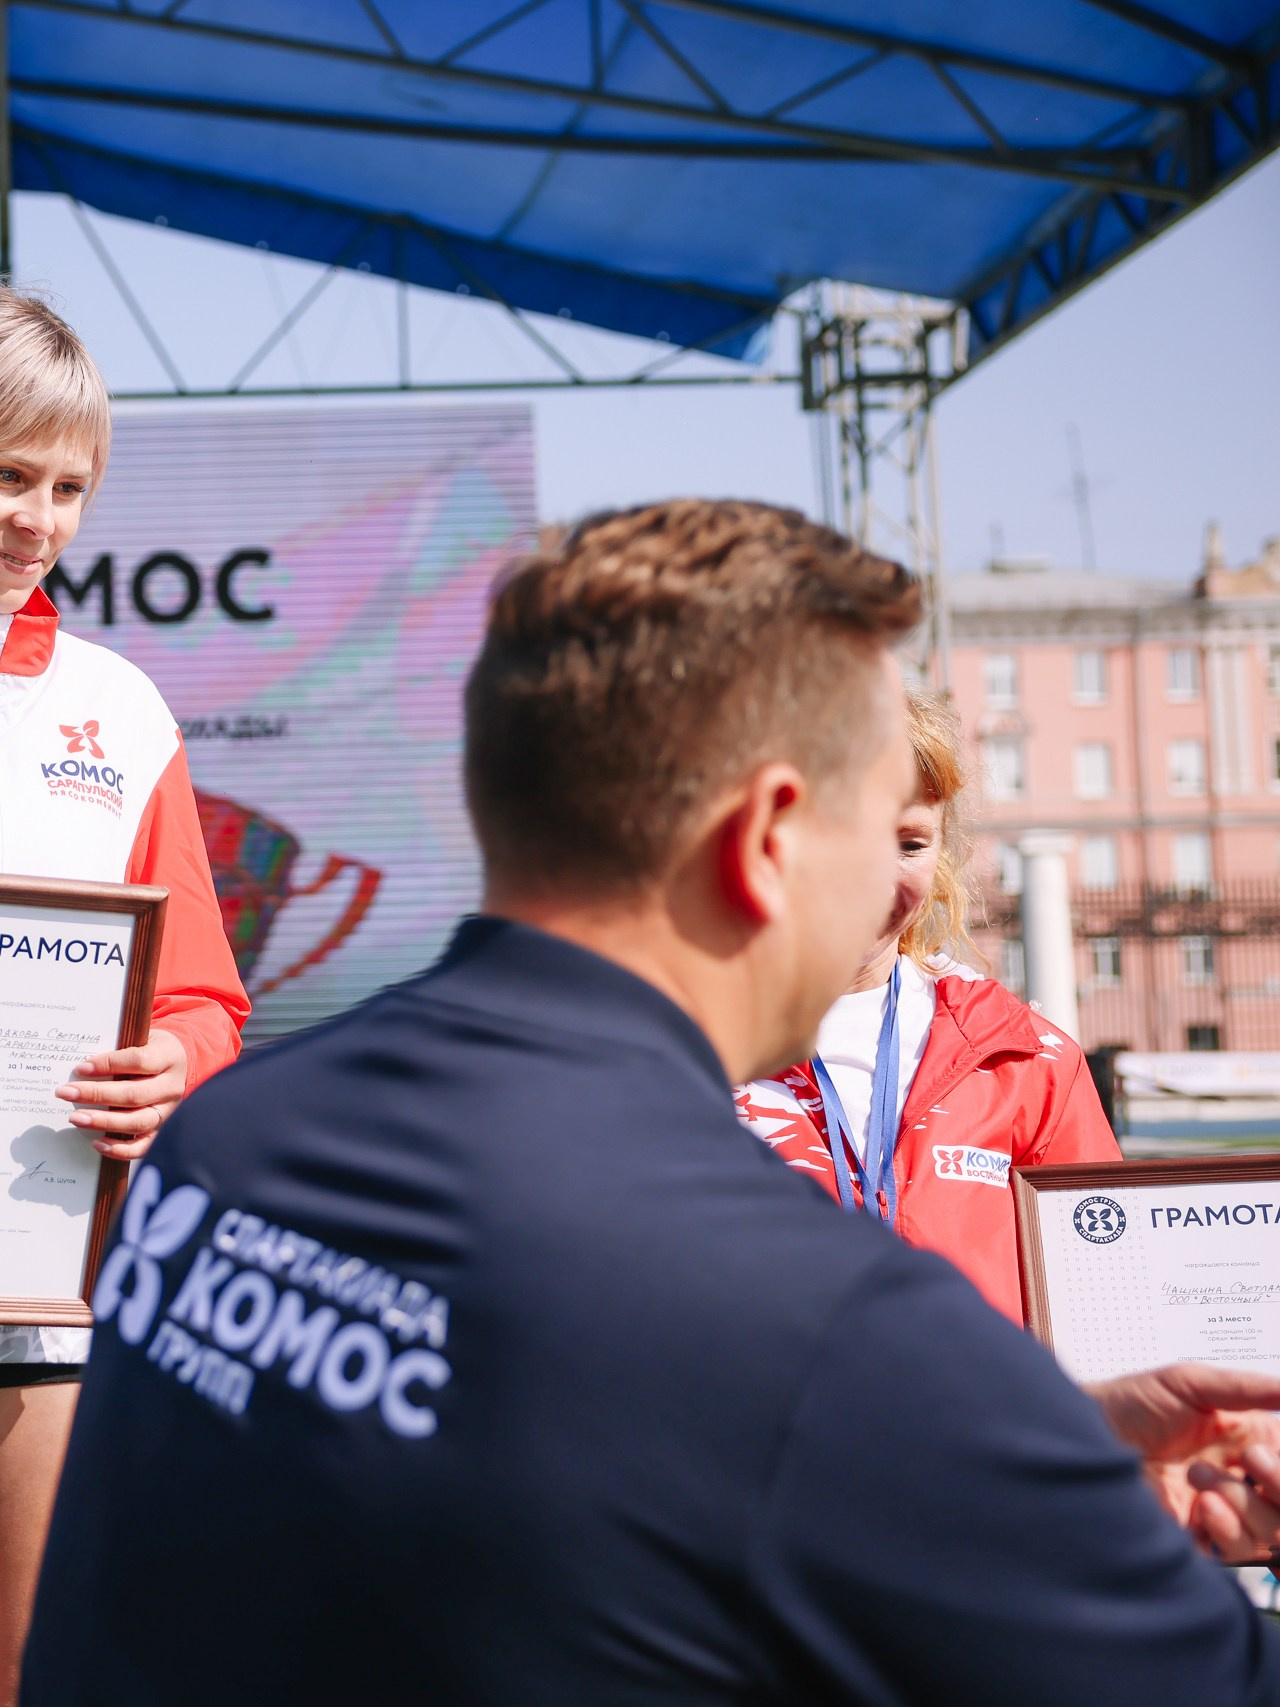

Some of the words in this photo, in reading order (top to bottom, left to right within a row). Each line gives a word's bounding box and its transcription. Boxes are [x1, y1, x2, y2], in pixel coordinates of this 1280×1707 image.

[45, 548, 277, 626] МОС
[40, 760, 124, 795] КОМОС
[47, 779, 123, 810] САРАПУЛЬСКИЙ
[25, 1064, 52, 1072] место
[1076, 1196, 1099, 1214] КОМОС
[1100, 1197, 1121, 1213] ГРУПП
[1078, 1226, 1124, 1244] СПАРТАКИАДА
[213, 1208, 450, 1349] СПАРТАКИАДА
[167, 1246, 452, 1439] КОМОС
[147, 1320, 255, 1415] ГРУПП
